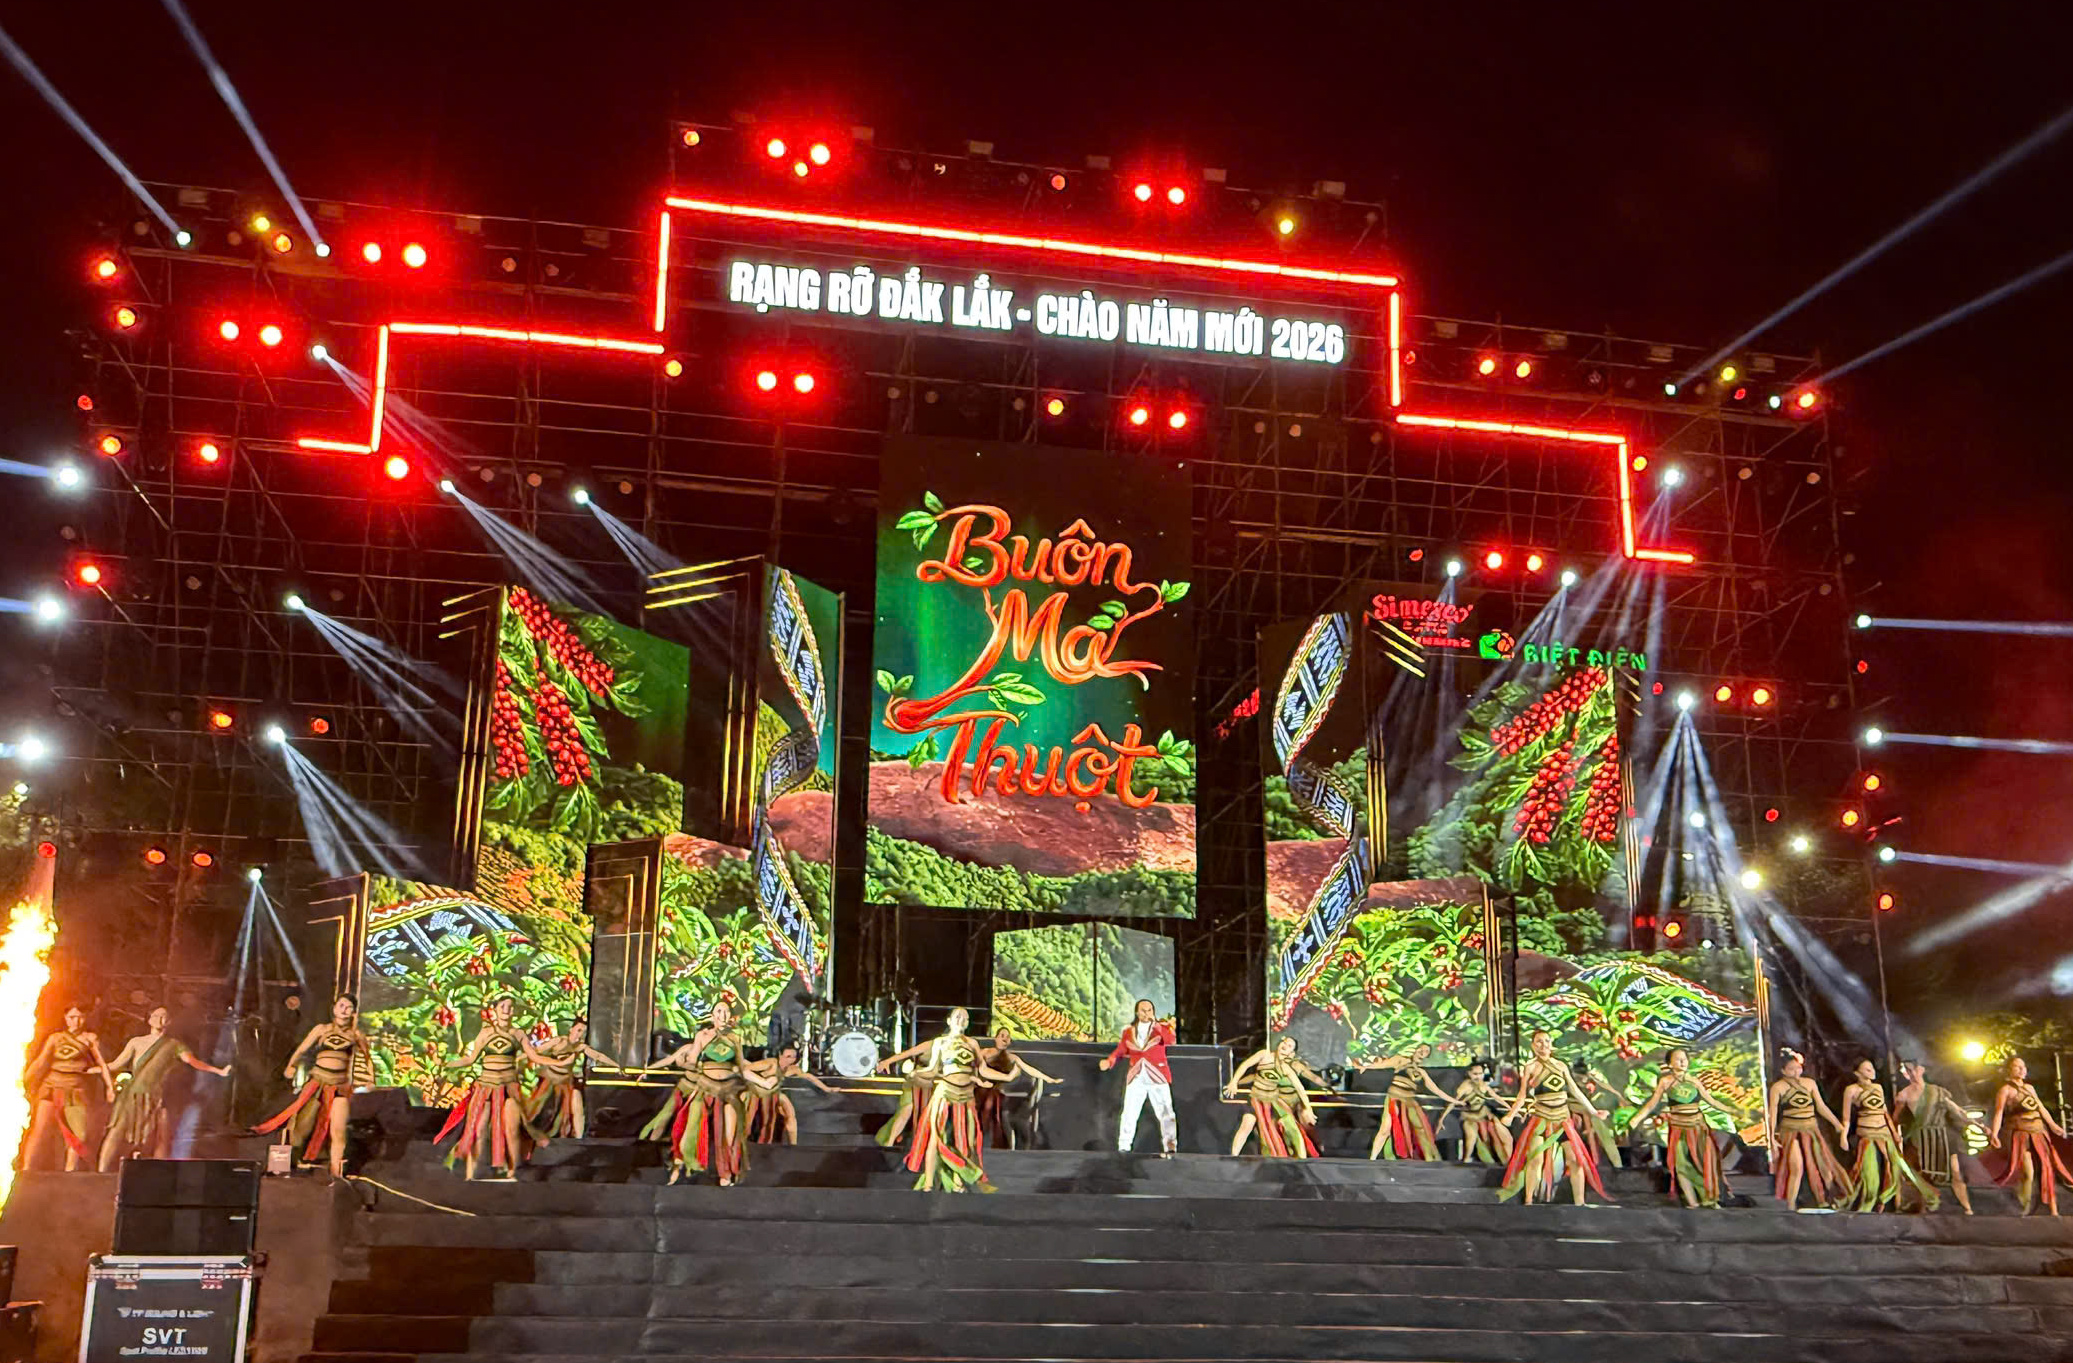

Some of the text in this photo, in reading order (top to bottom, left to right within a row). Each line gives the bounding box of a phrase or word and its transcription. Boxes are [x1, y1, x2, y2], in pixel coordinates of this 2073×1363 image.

[730, 261, 1345, 364] RẠNG RỠ ĐẮK LẮK - CHÀO NĂM MỚI 2026
[916, 505, 1140, 595] Buôn
[925, 708, 1159, 814] Thuột
[142, 1327, 187, 1345] SVT
